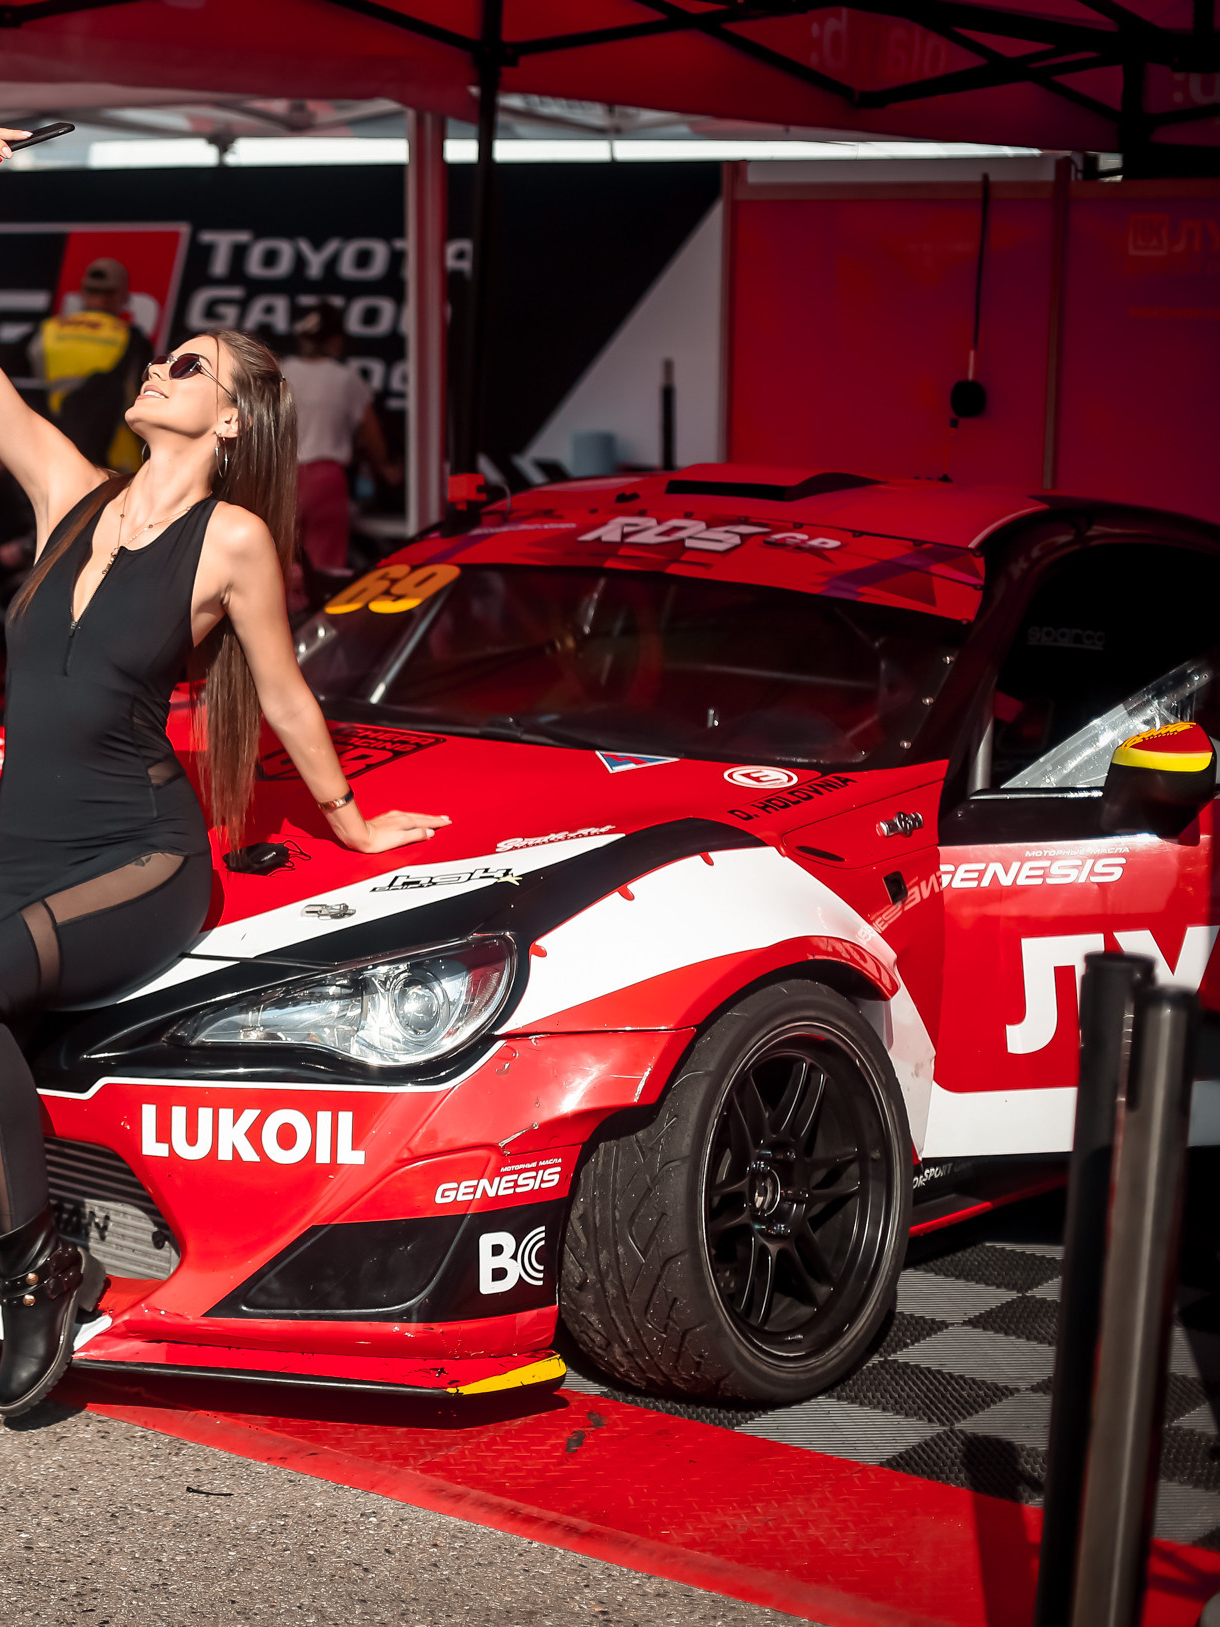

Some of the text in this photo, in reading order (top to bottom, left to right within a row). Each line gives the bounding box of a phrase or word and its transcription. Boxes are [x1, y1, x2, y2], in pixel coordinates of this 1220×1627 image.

[577, 516, 771, 551] RDS
[324, 563, 461, 614] 69
[1027, 625, 1106, 647] sparco
[727, 809, 760, 821] D.
[141, 1103, 366, 1165] LUKOIL
[500, 1157, 562, 1172] МОТОРНЫЕ МАСЛА
[434, 1166, 562, 1204] GENESIS
